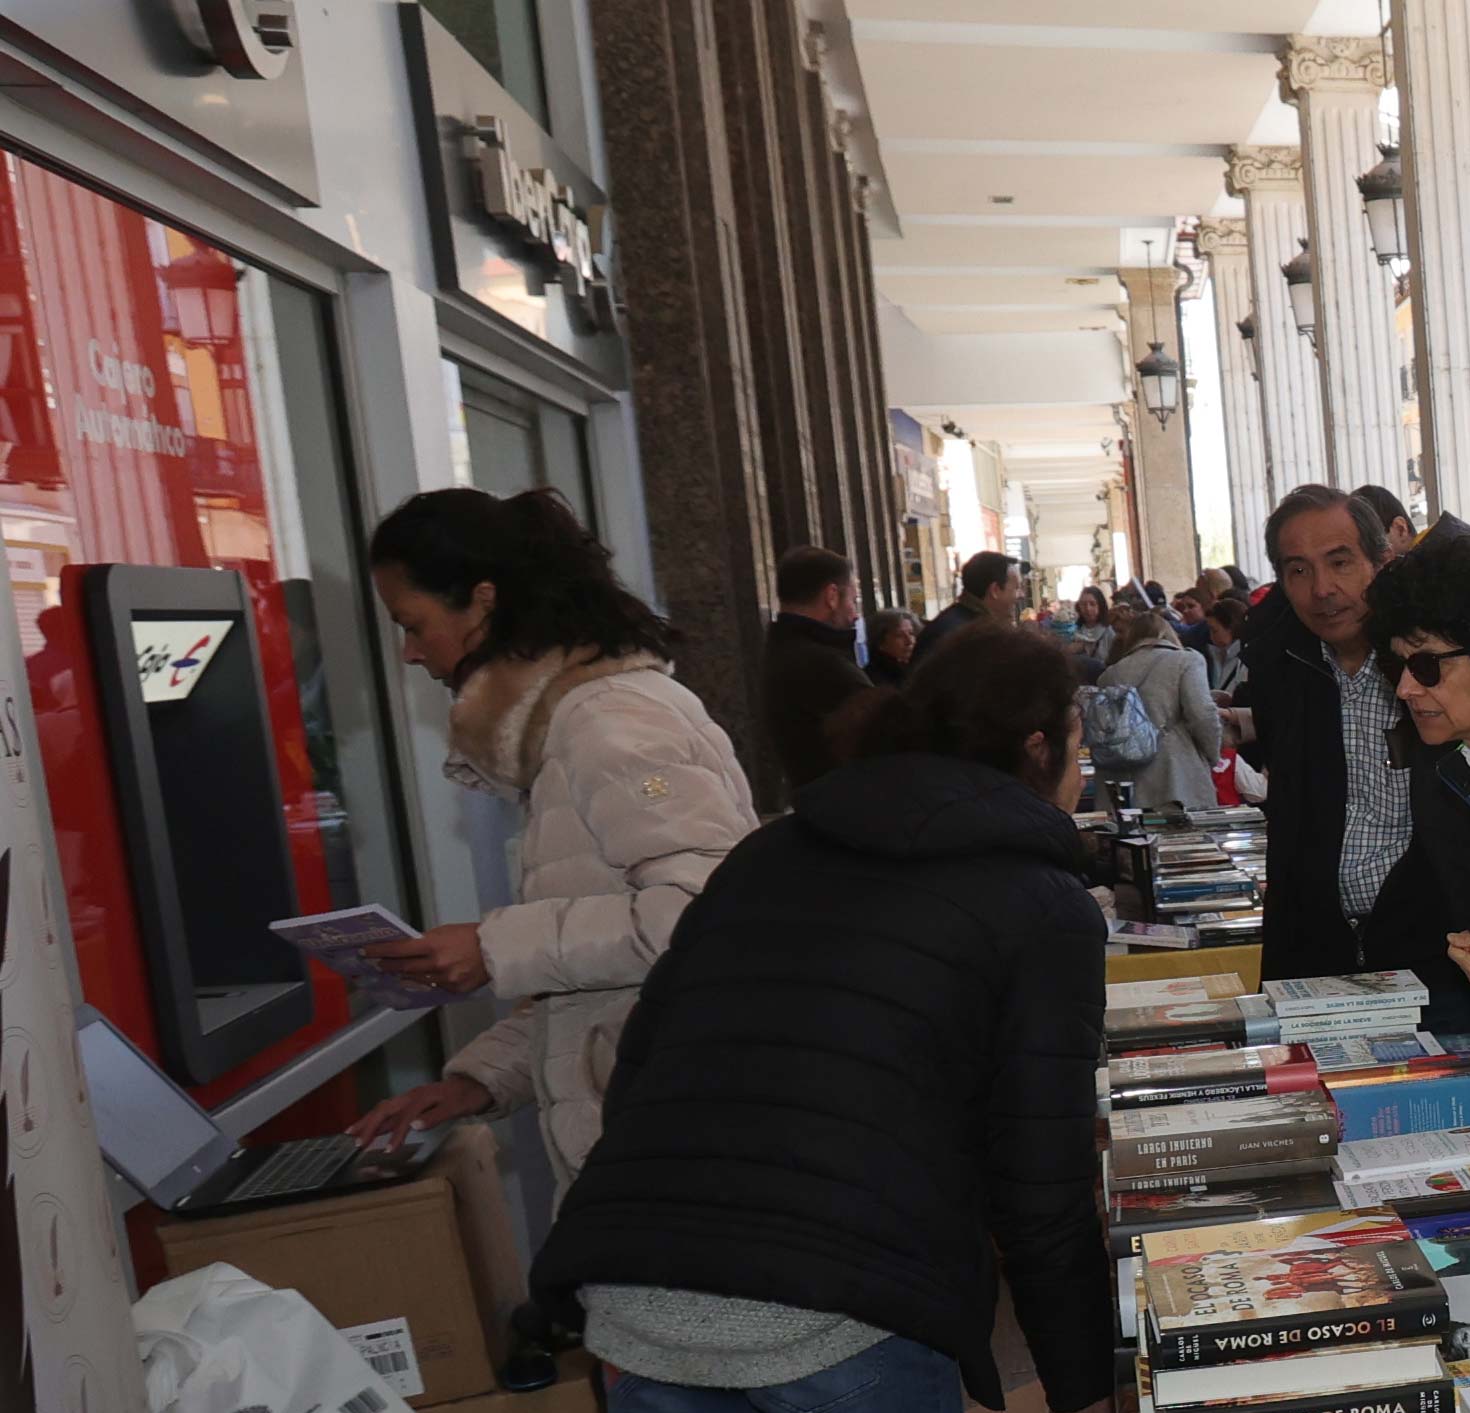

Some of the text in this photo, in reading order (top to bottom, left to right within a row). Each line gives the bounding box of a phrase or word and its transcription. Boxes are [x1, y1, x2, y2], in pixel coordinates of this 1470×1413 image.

[1137, 1137, 1213, 1156] LARGO INVIERNO
[1239, 1138, 1294, 1152] JUAN VILCHES
[1156, 1153, 1198, 1169] EN PARÍS
[1223, 1261, 1247, 1294] ROMA
[1215, 1317, 1395, 1351] EL OCASO DE ROMA
